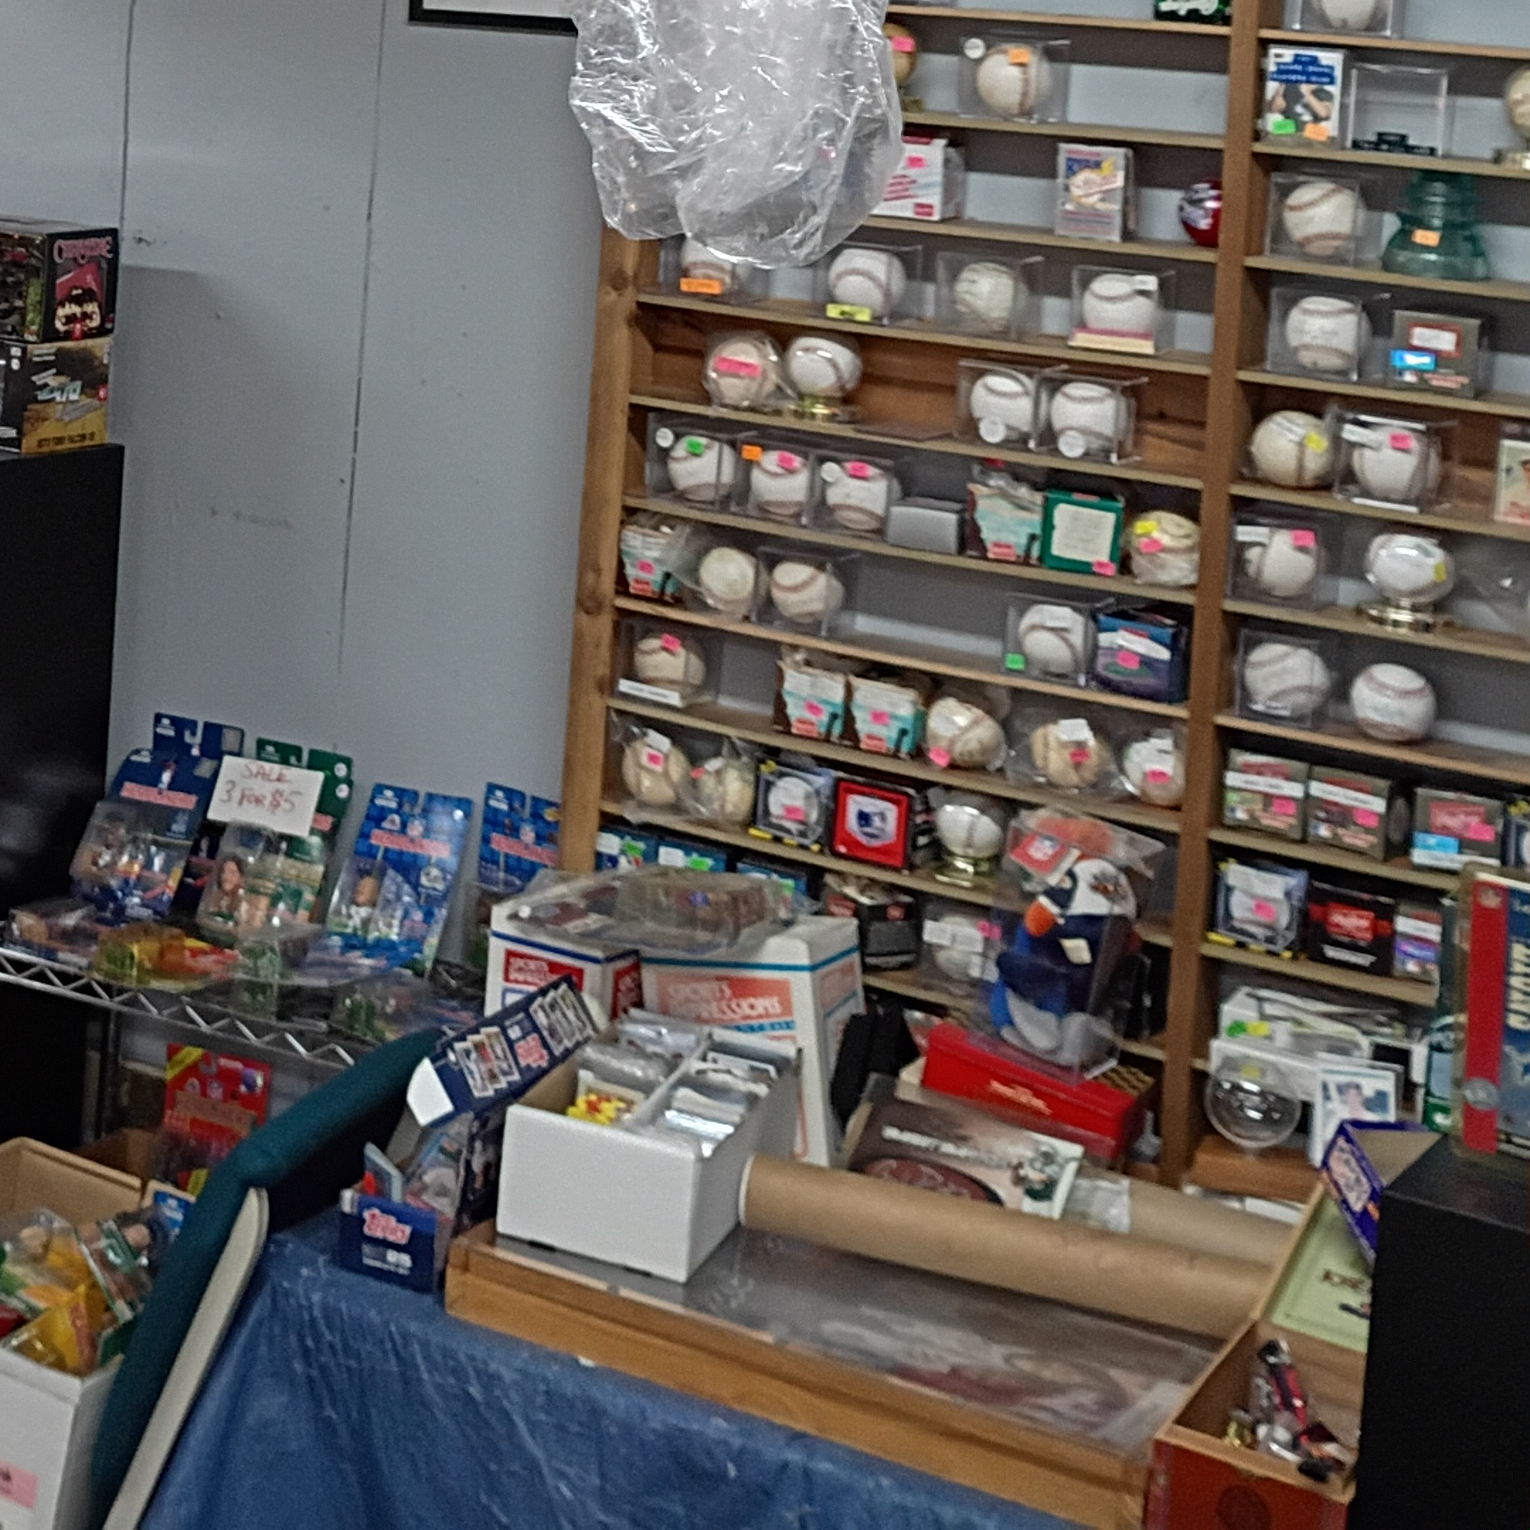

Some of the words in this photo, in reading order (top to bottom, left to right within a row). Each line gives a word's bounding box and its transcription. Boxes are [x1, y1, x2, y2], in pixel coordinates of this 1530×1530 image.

[244, 761, 292, 784] SALE
[218, 780, 237, 805] 3
[238, 788, 267, 808] FOR
[268, 788, 303, 815] $5
